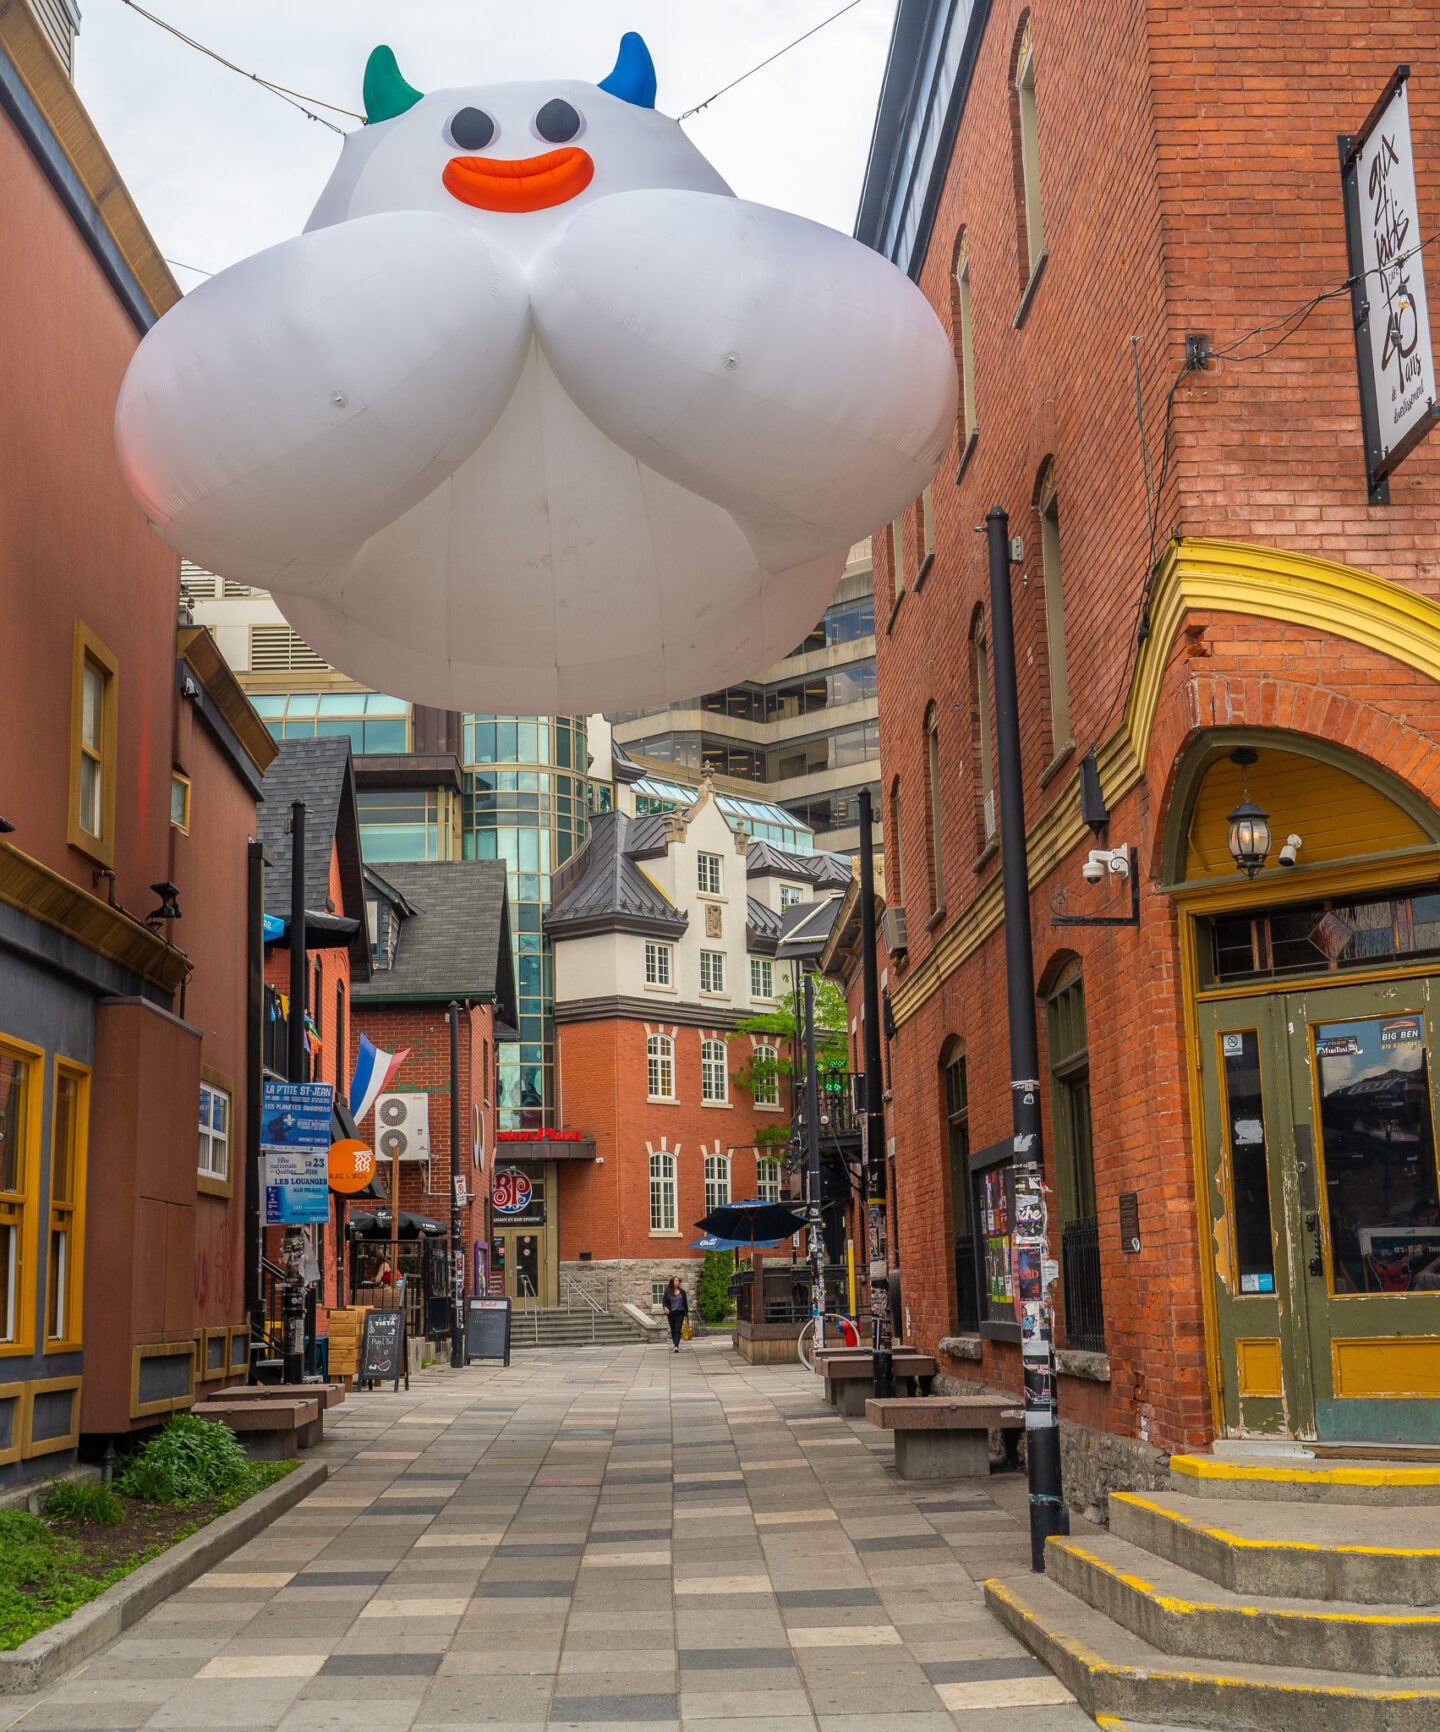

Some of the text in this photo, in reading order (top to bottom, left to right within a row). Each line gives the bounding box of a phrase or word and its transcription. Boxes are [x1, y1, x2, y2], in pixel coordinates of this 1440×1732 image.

[1405, 352, 1422, 383] ans
[1382, 1030, 1419, 1041] BIG BEN
[266, 1084, 275, 1094] LA
[300, 1087, 331, 1097] ST-JEAN
[496, 1129, 536, 1141] ston
[313, 1158, 325, 1168] 23
